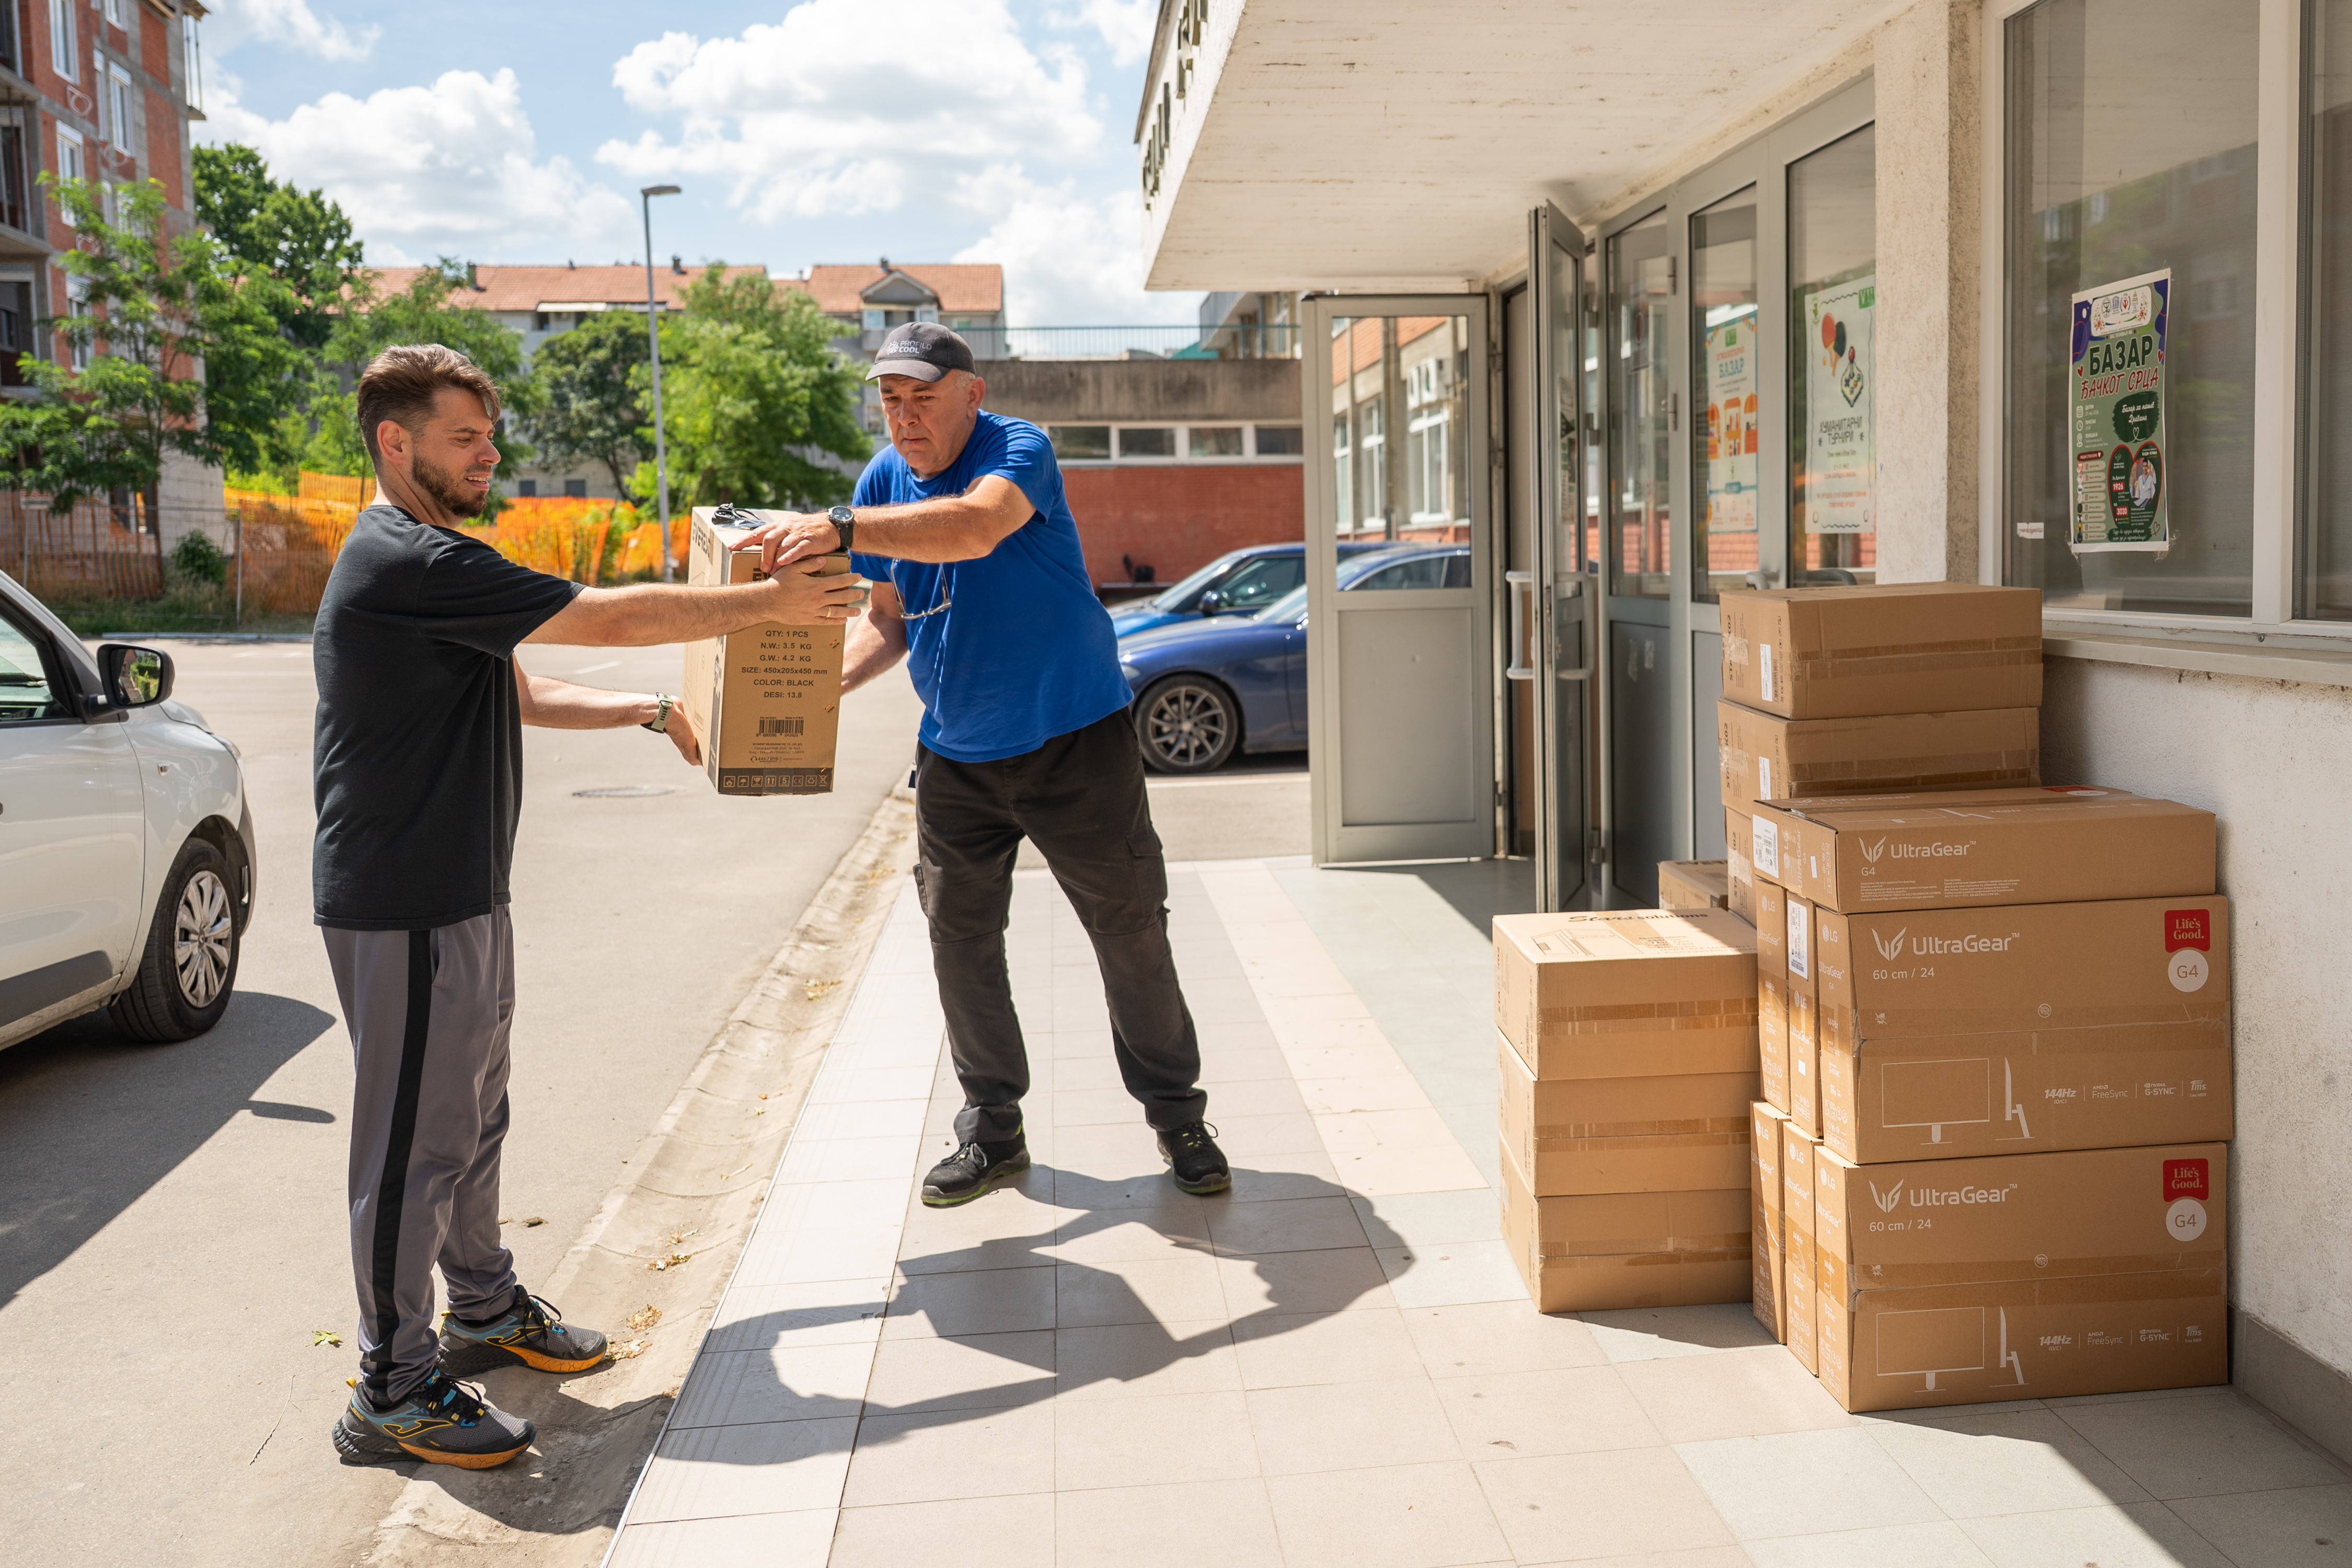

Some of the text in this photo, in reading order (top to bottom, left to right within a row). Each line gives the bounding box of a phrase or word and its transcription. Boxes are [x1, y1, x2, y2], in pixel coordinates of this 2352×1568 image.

[900, 340, 932, 350] PROFILO
[2089, 334, 2153, 376] БАЗАР
[1719, 358, 1744, 378] БАЗАР
[2081, 366, 2159, 400] ЂАЧКОГ СРЦА
[1819, 416, 1862, 433] ХУМАНИТАРНИ
[1827, 431, 1853, 444] ТУРНИРИ
[1861, 867, 1876, 876] G4
[1768, 901, 1775, 912] LG
[1830, 929, 1838, 942] LG
[2173, 929, 2205, 940] Good.
[1873, 967, 1935, 979] 60 cm / 24
[2177, 965, 2199, 978] G4
[1800, 996, 1807, 1009] LG
[2044, 1088, 2077, 1098] 144Hz
[2092, 1089, 2128, 1099] FreeSync
[1761, 1126, 1769, 1140] LG
[1796, 1149, 1804, 1164] LG
[1828, 1174, 1836, 1190] LG
[2172, 1178, 2203, 1189] Good.
[1869, 1219, 1932, 1231] 60 cm / 24
[2175, 1214, 2196, 1228] G4
[2039, 1335, 2071, 1346] 144Hz
[2088, 1336, 2123, 1346] FreeSync
